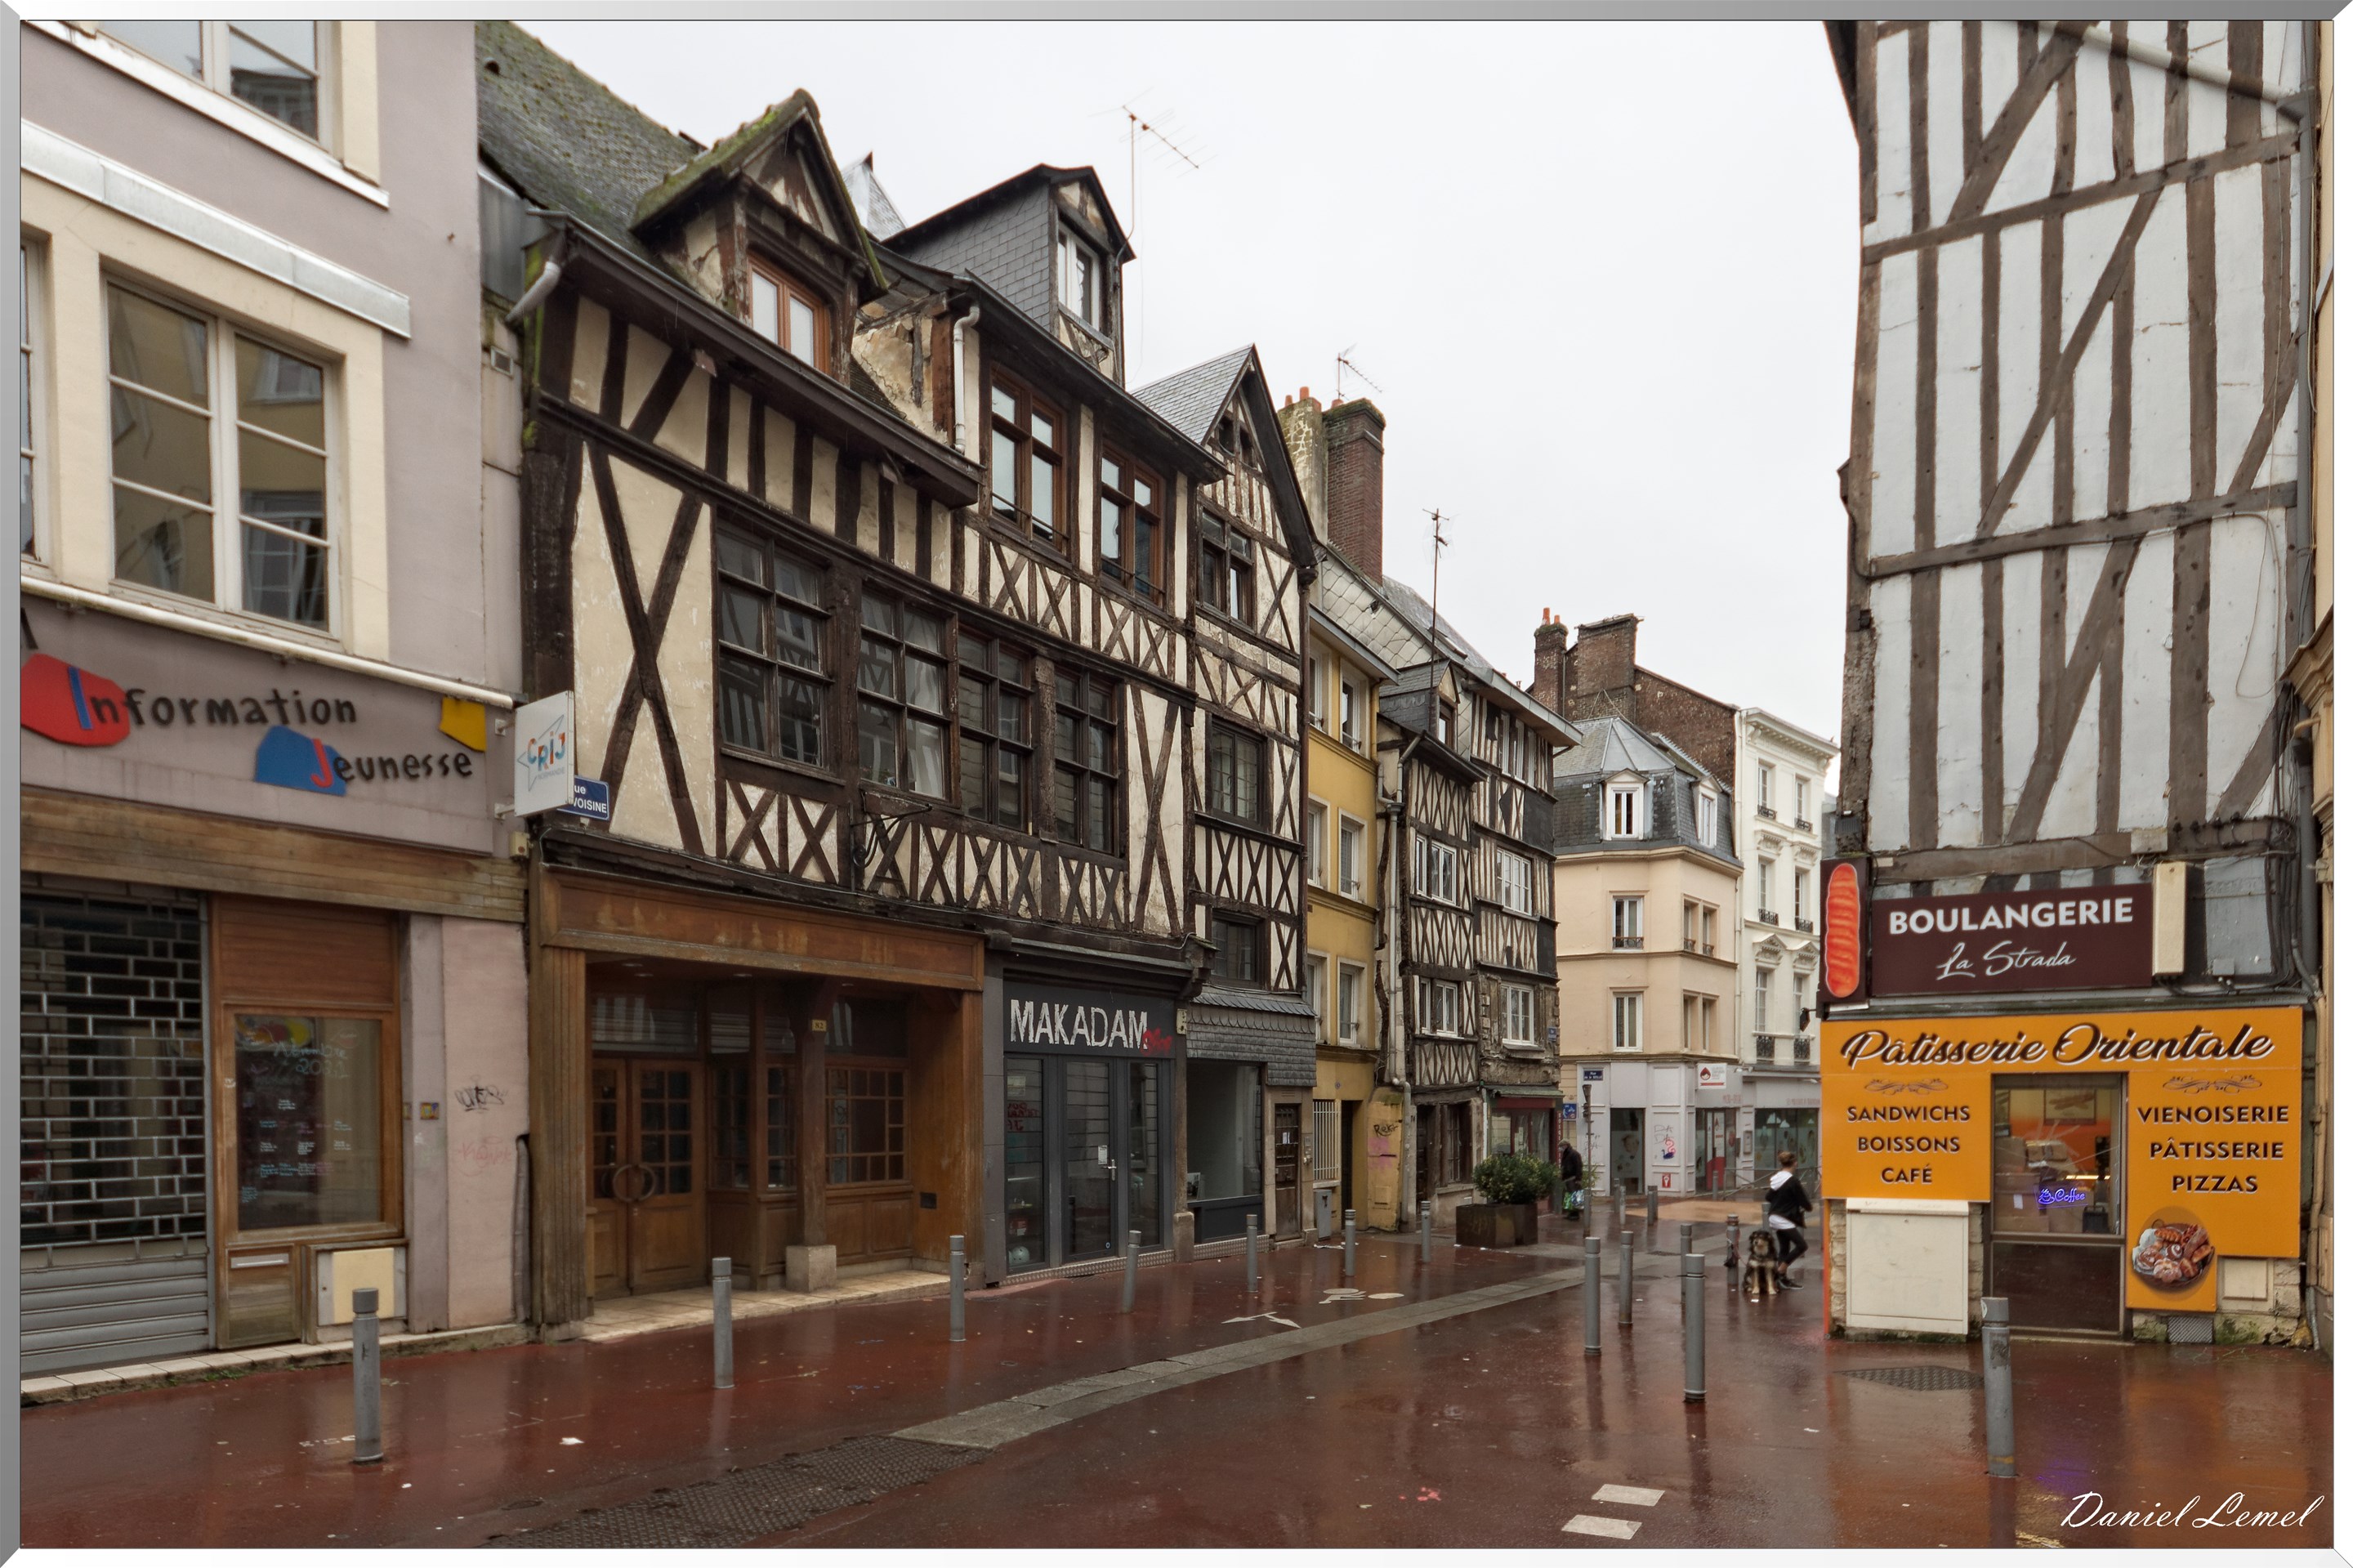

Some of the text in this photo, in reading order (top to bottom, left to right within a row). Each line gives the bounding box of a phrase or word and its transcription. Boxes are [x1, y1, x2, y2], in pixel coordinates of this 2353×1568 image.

[68, 666, 357, 730] Information
[310, 738, 474, 788] Jeunesse
[574, 784, 587, 795] ue
[574, 797, 607, 814] VOISINE
[1889, 897, 2133, 936] BOULANGERIE
[1936, 940, 2077, 981] La Strada
[1010, 998, 1149, 1050] MAKADAM
[1840, 1022, 2276, 1070] Pâtisserie Orientale
[1846, 1106, 1971, 1124] SANDWICHS
[2136, 1105, 2289, 1124] VIENOISERIE
[1857, 1136, 1961, 1154] BOISSONS
[2150, 1138, 2284, 1161] PÂTISSERIE
[1881, 1162, 1933, 1185] CAFÉ
[2172, 1174, 2259, 1194] PIZZAS
[2055, 1187, 2086, 1203] Coffee
